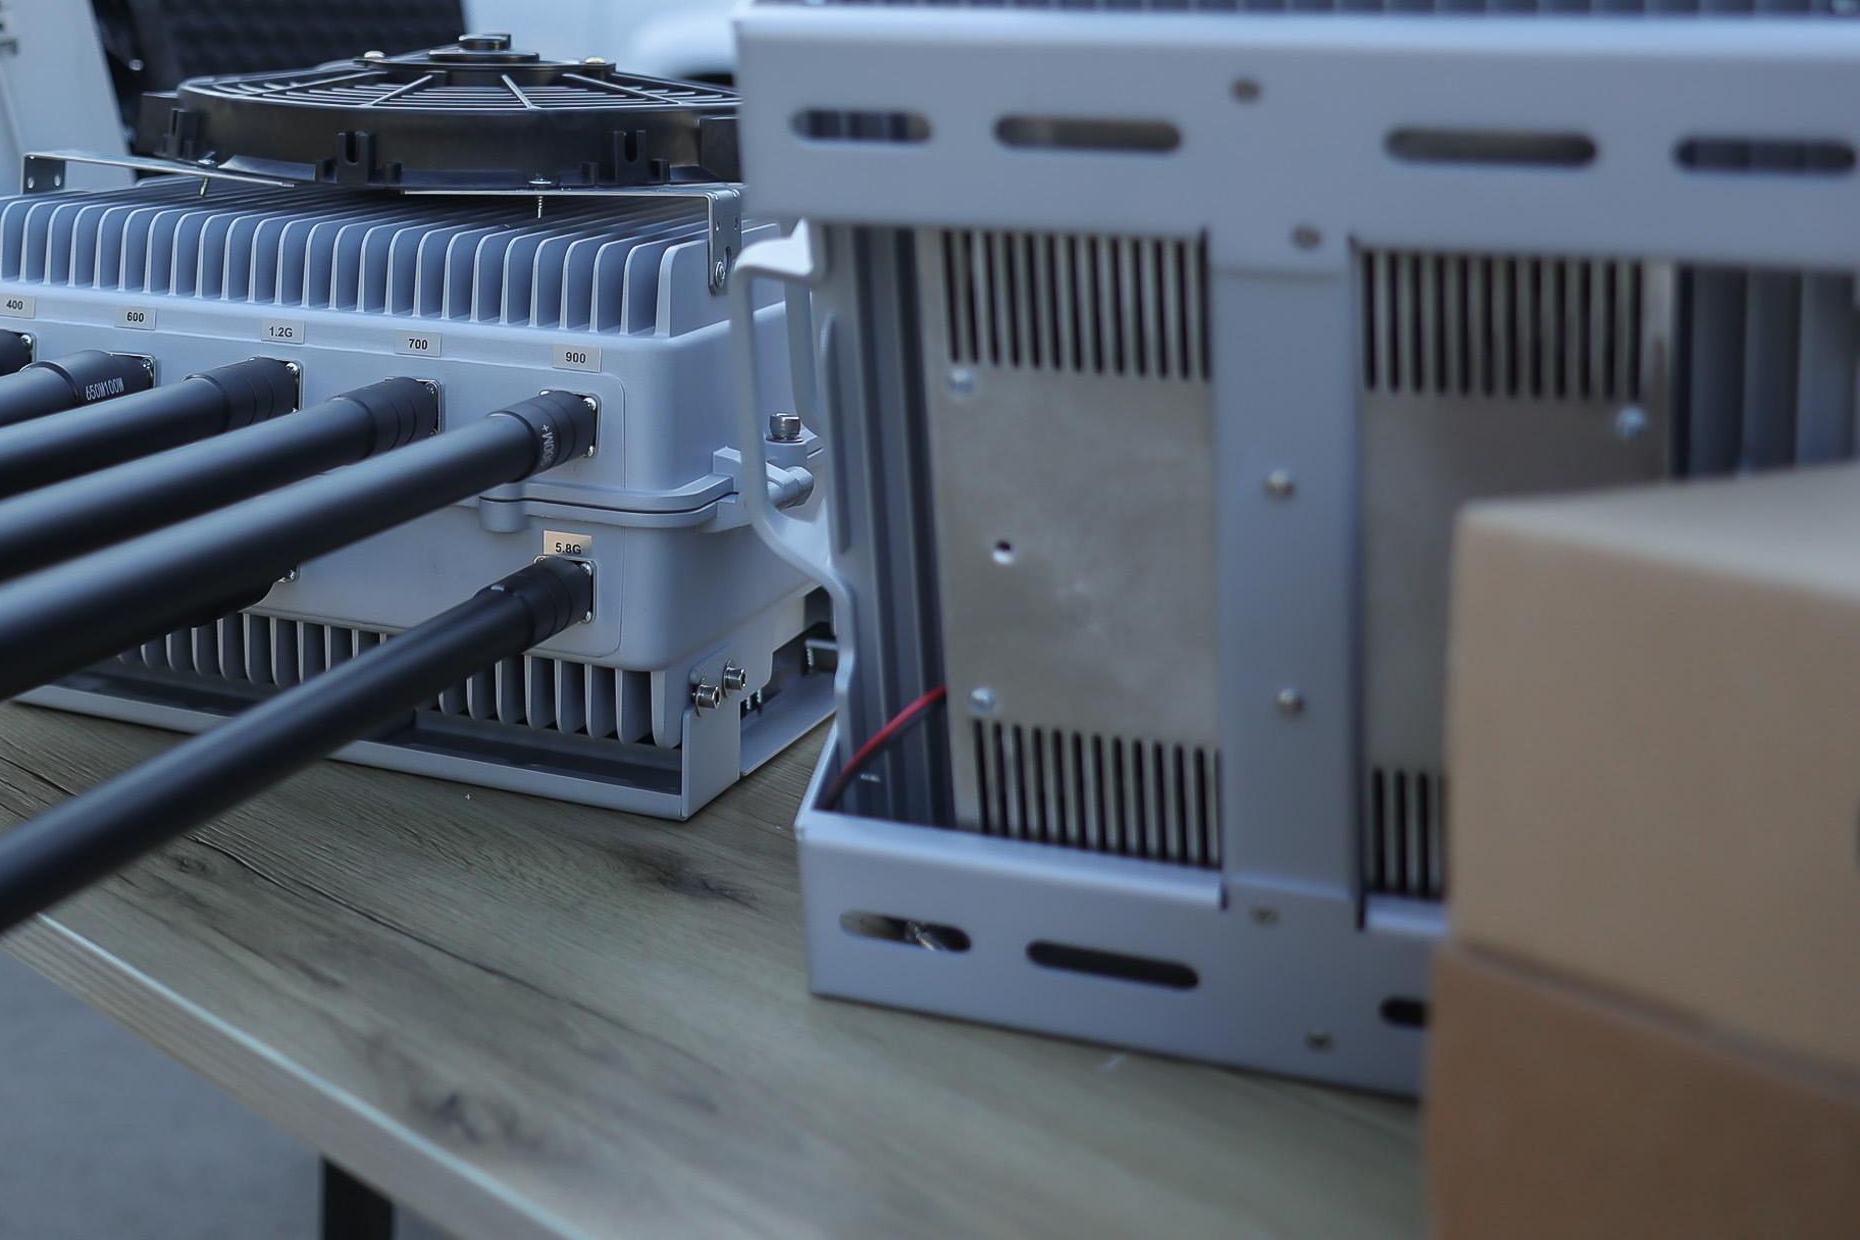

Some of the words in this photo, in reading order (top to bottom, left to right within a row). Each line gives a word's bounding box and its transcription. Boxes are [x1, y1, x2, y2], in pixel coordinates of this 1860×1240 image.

[6, 298, 24, 311] 400
[126, 311, 145, 323] 600
[269, 326, 293, 338] 1.2G
[408, 338, 428, 350] 700
[565, 351, 587, 364] 900
[555, 542, 582, 555] 5.8G
